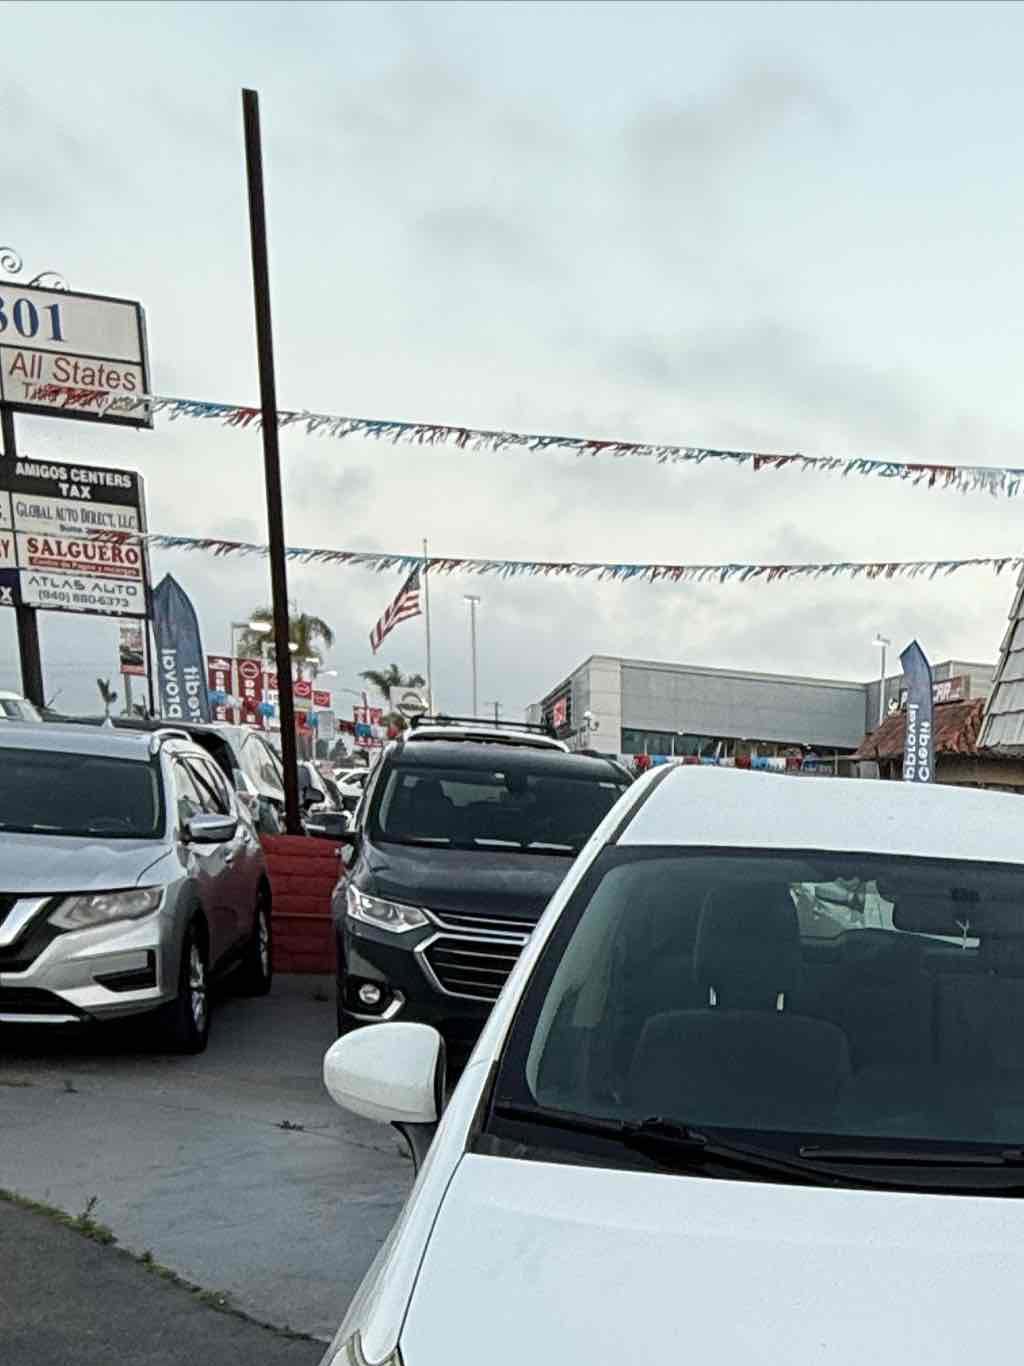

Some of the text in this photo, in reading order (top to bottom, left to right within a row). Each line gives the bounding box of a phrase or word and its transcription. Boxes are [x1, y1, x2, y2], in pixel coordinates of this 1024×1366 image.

[9, 352, 137, 391] All States
[16, 462, 132, 488] AMIGOS CENTERS
[58, 483, 92, 499] TAX
[16, 502, 53, 520] GLOBAL
[27, 537, 139, 565] SALGUERO
[28, 576, 138, 596] ATLAS AUTO
